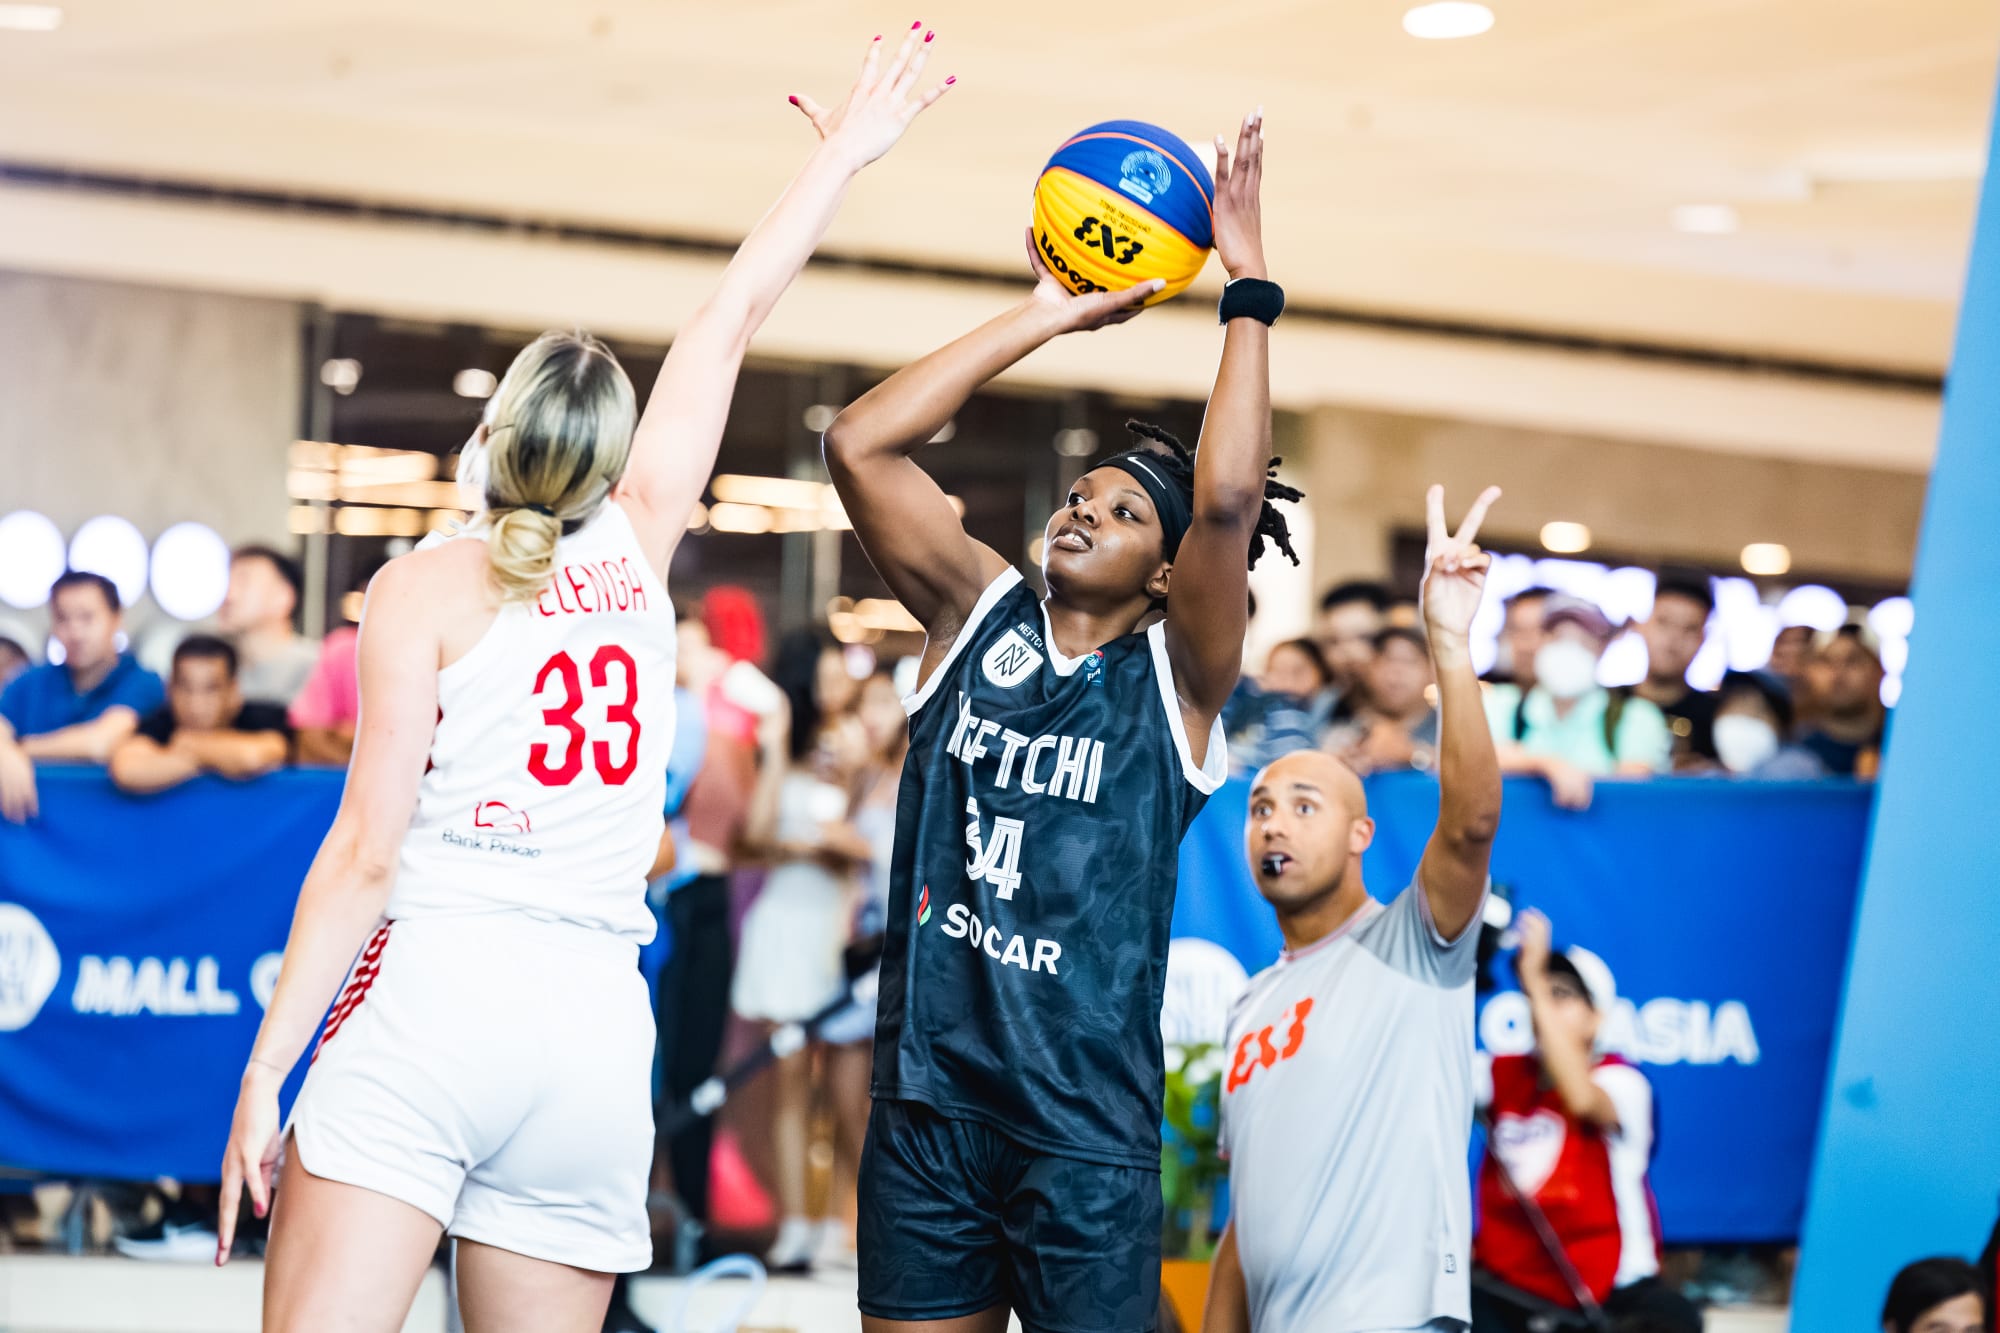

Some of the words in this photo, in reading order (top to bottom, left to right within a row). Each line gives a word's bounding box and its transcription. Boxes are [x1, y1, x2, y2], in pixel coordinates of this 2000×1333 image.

[528, 557, 647, 617] ELENGA
[528, 645, 641, 786] 33
[442, 828, 483, 850] Bank
[940, 903, 1062, 975] SOCAR
[72, 955, 240, 1016] MALL
